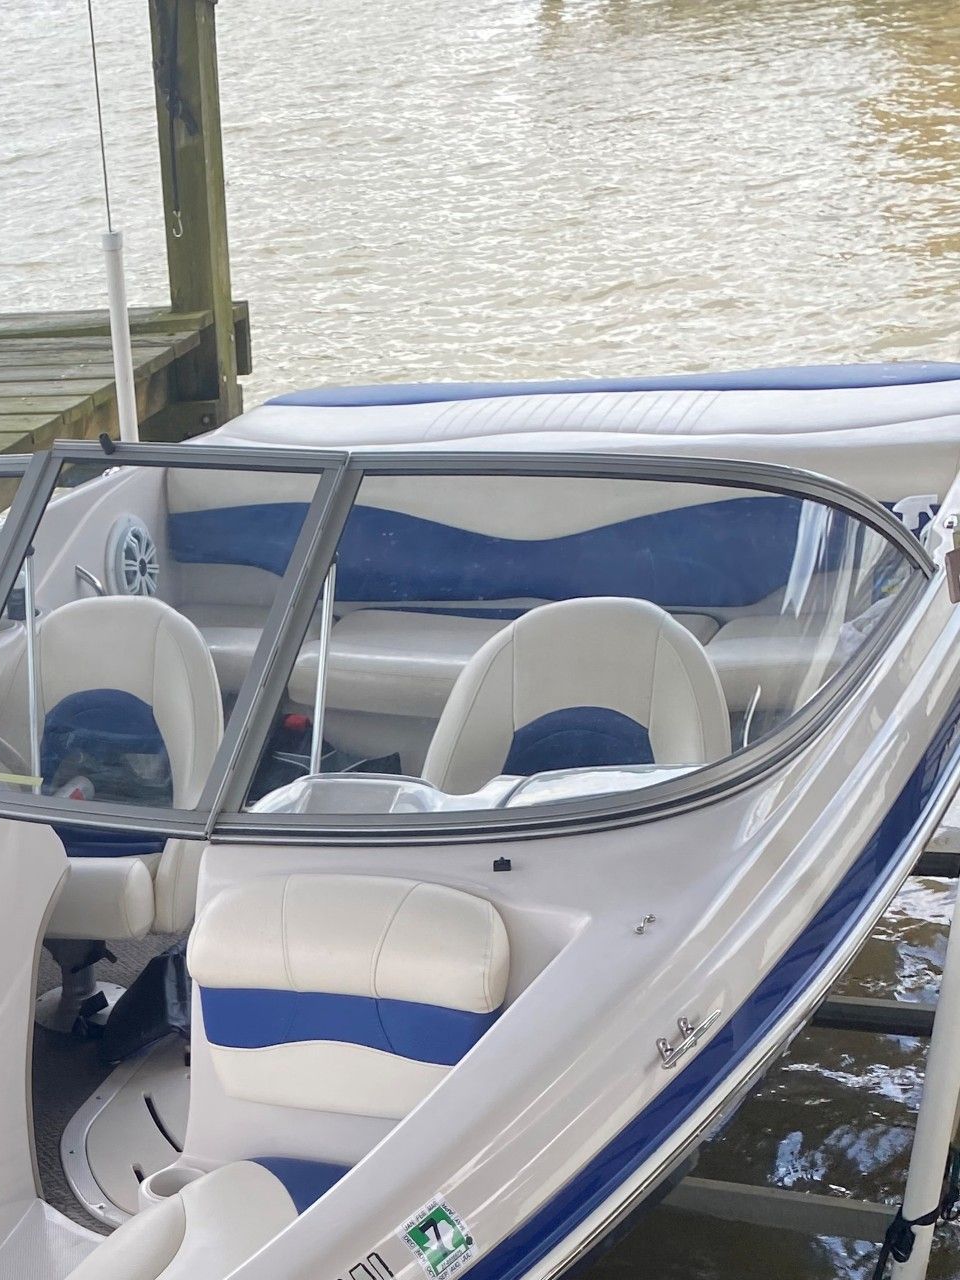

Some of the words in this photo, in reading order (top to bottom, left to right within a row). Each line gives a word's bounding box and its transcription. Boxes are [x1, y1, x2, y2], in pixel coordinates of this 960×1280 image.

[404, 1221, 415, 1230] JAN
[415, 1210, 427, 1220] FEB
[404, 1235, 415, 1247] DEC
[420, 1218, 448, 1258] 7
[427, 1266, 436, 1278] OCT
